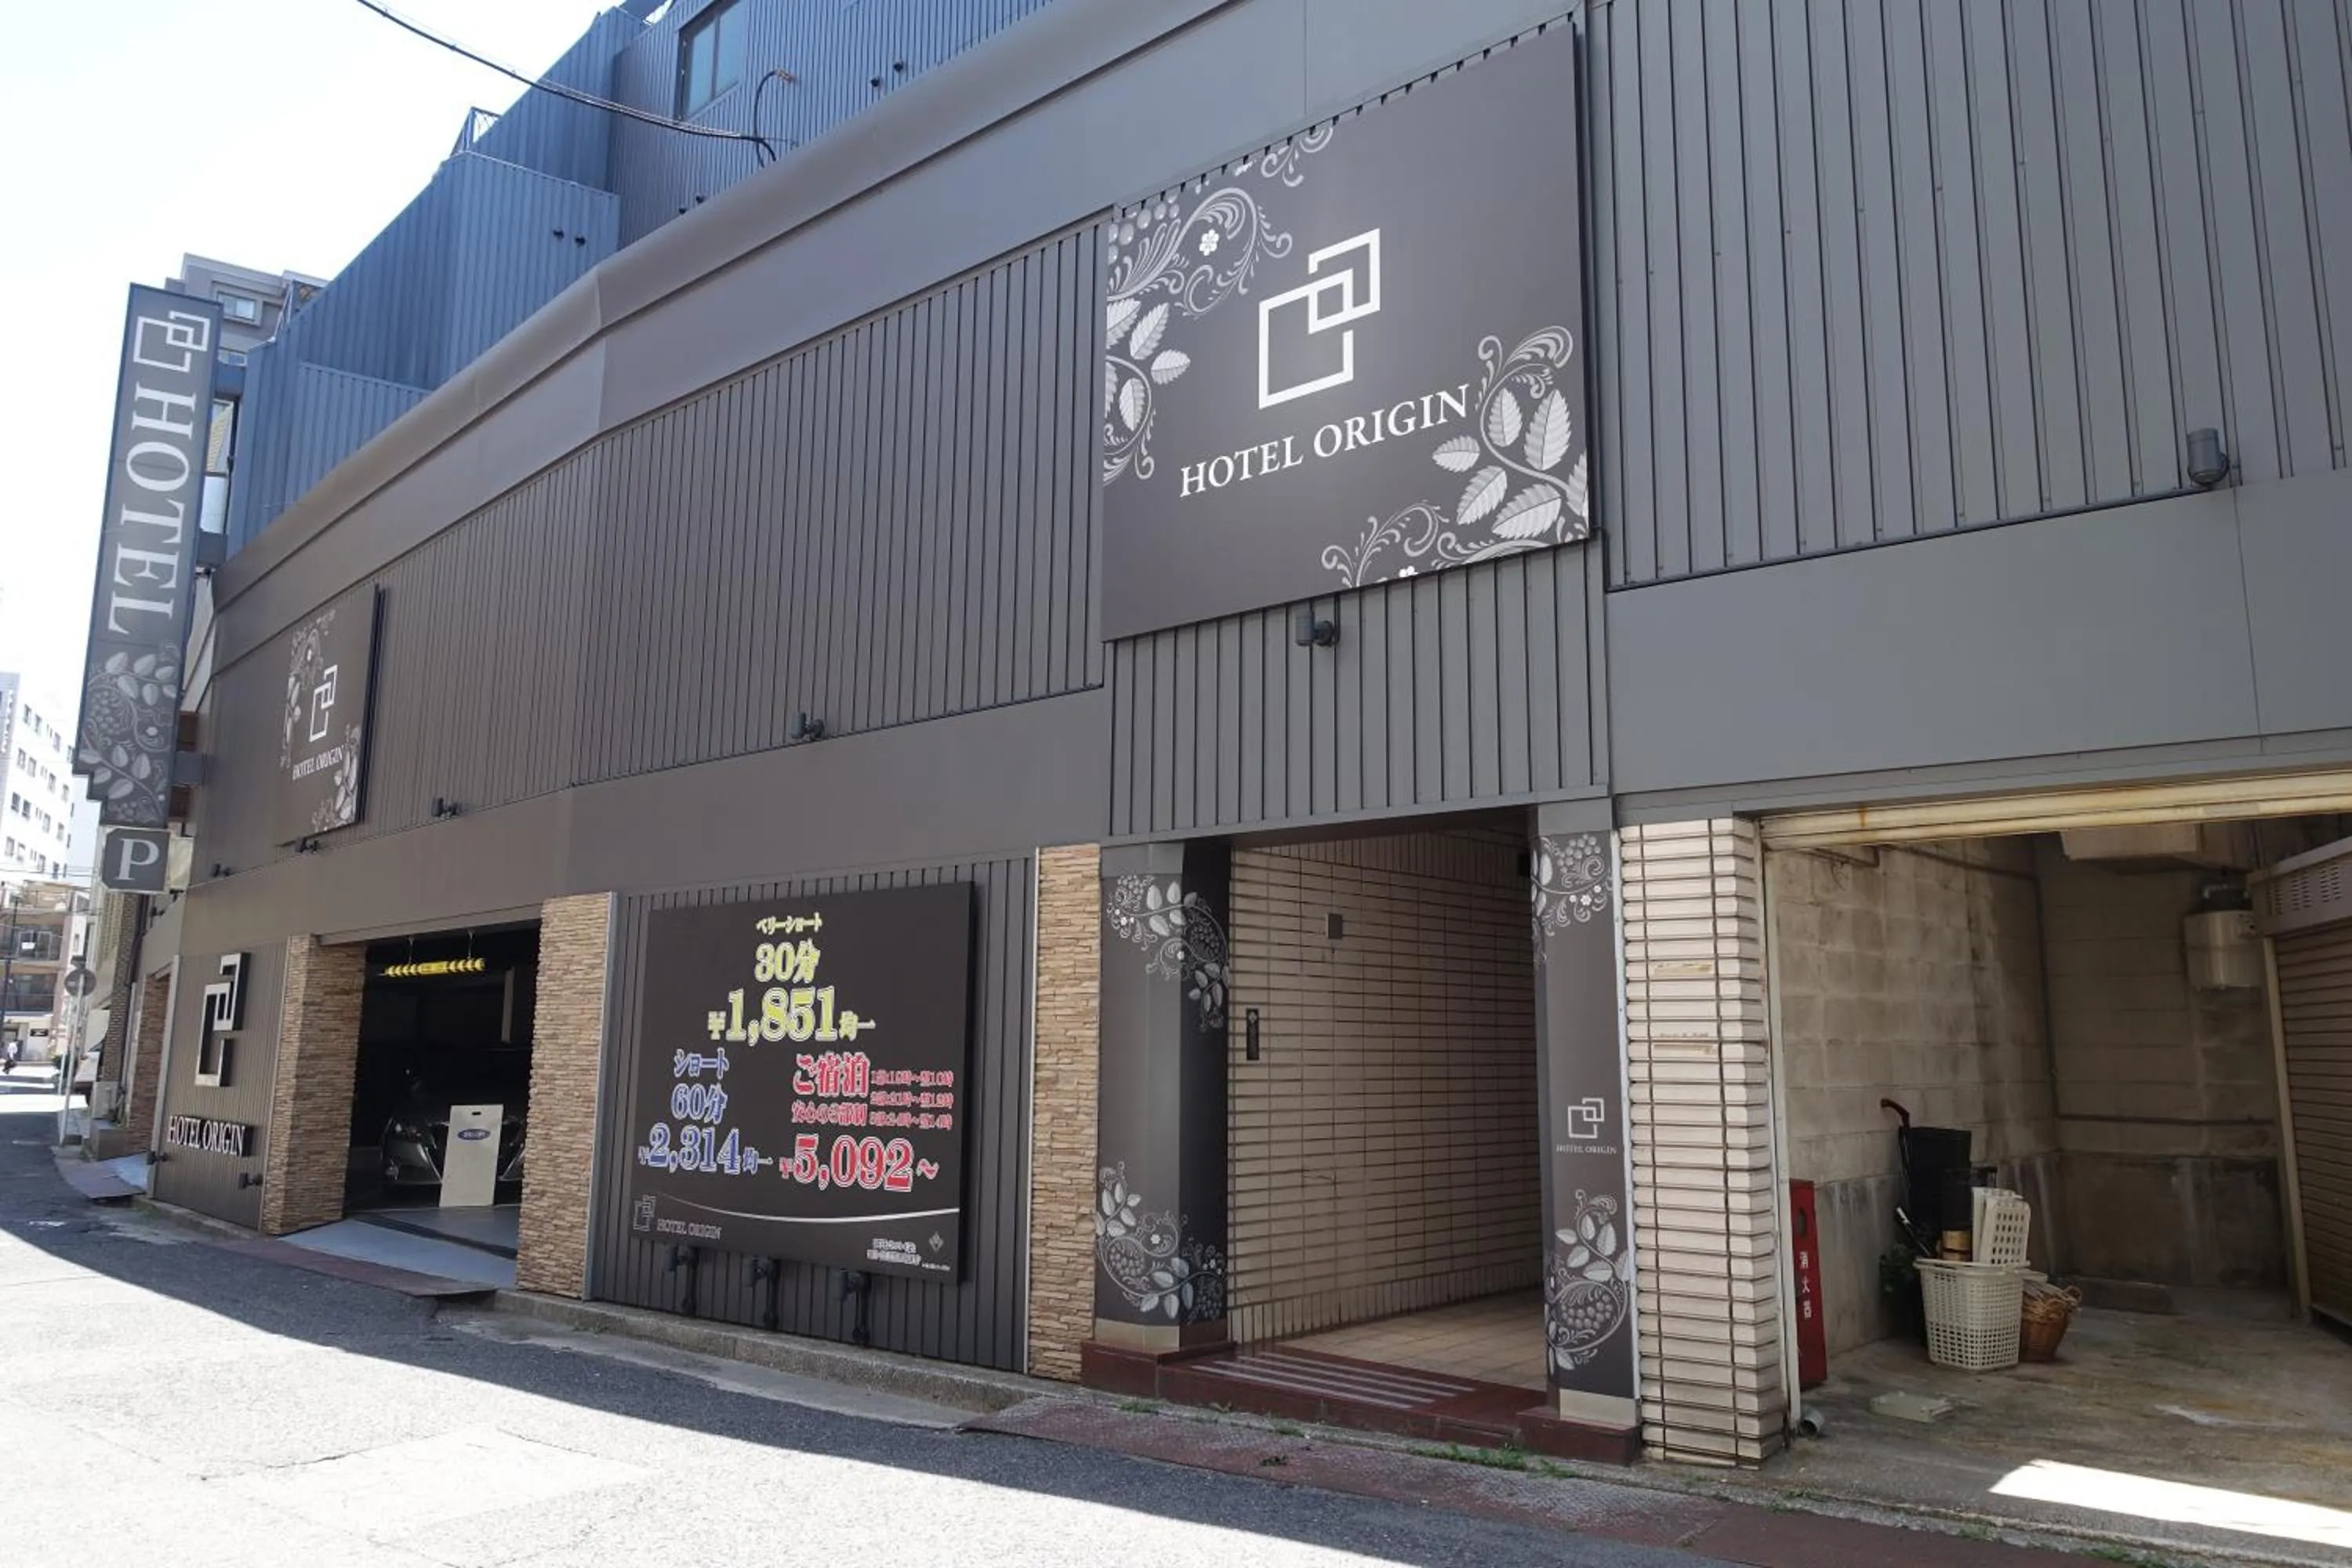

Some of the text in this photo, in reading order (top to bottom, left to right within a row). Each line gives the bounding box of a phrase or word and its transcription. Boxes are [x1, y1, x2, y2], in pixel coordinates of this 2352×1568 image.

[1180, 384, 1469, 498] HOTEL ORIGIN
[108, 382, 196, 635] HOTEL
[292, 757, 315, 780] HOTEL
[114, 838, 159, 880] P
[756, 912, 822, 935] ベリーショート
[754, 938, 821, 983] 30分
[674, 1047, 729, 1080] ショート
[793, 1051, 870, 1097] ご宿泊
[671, 1082, 728, 1124] 60分
[167, 1116, 245, 1157] HOTEL ORIGIN
